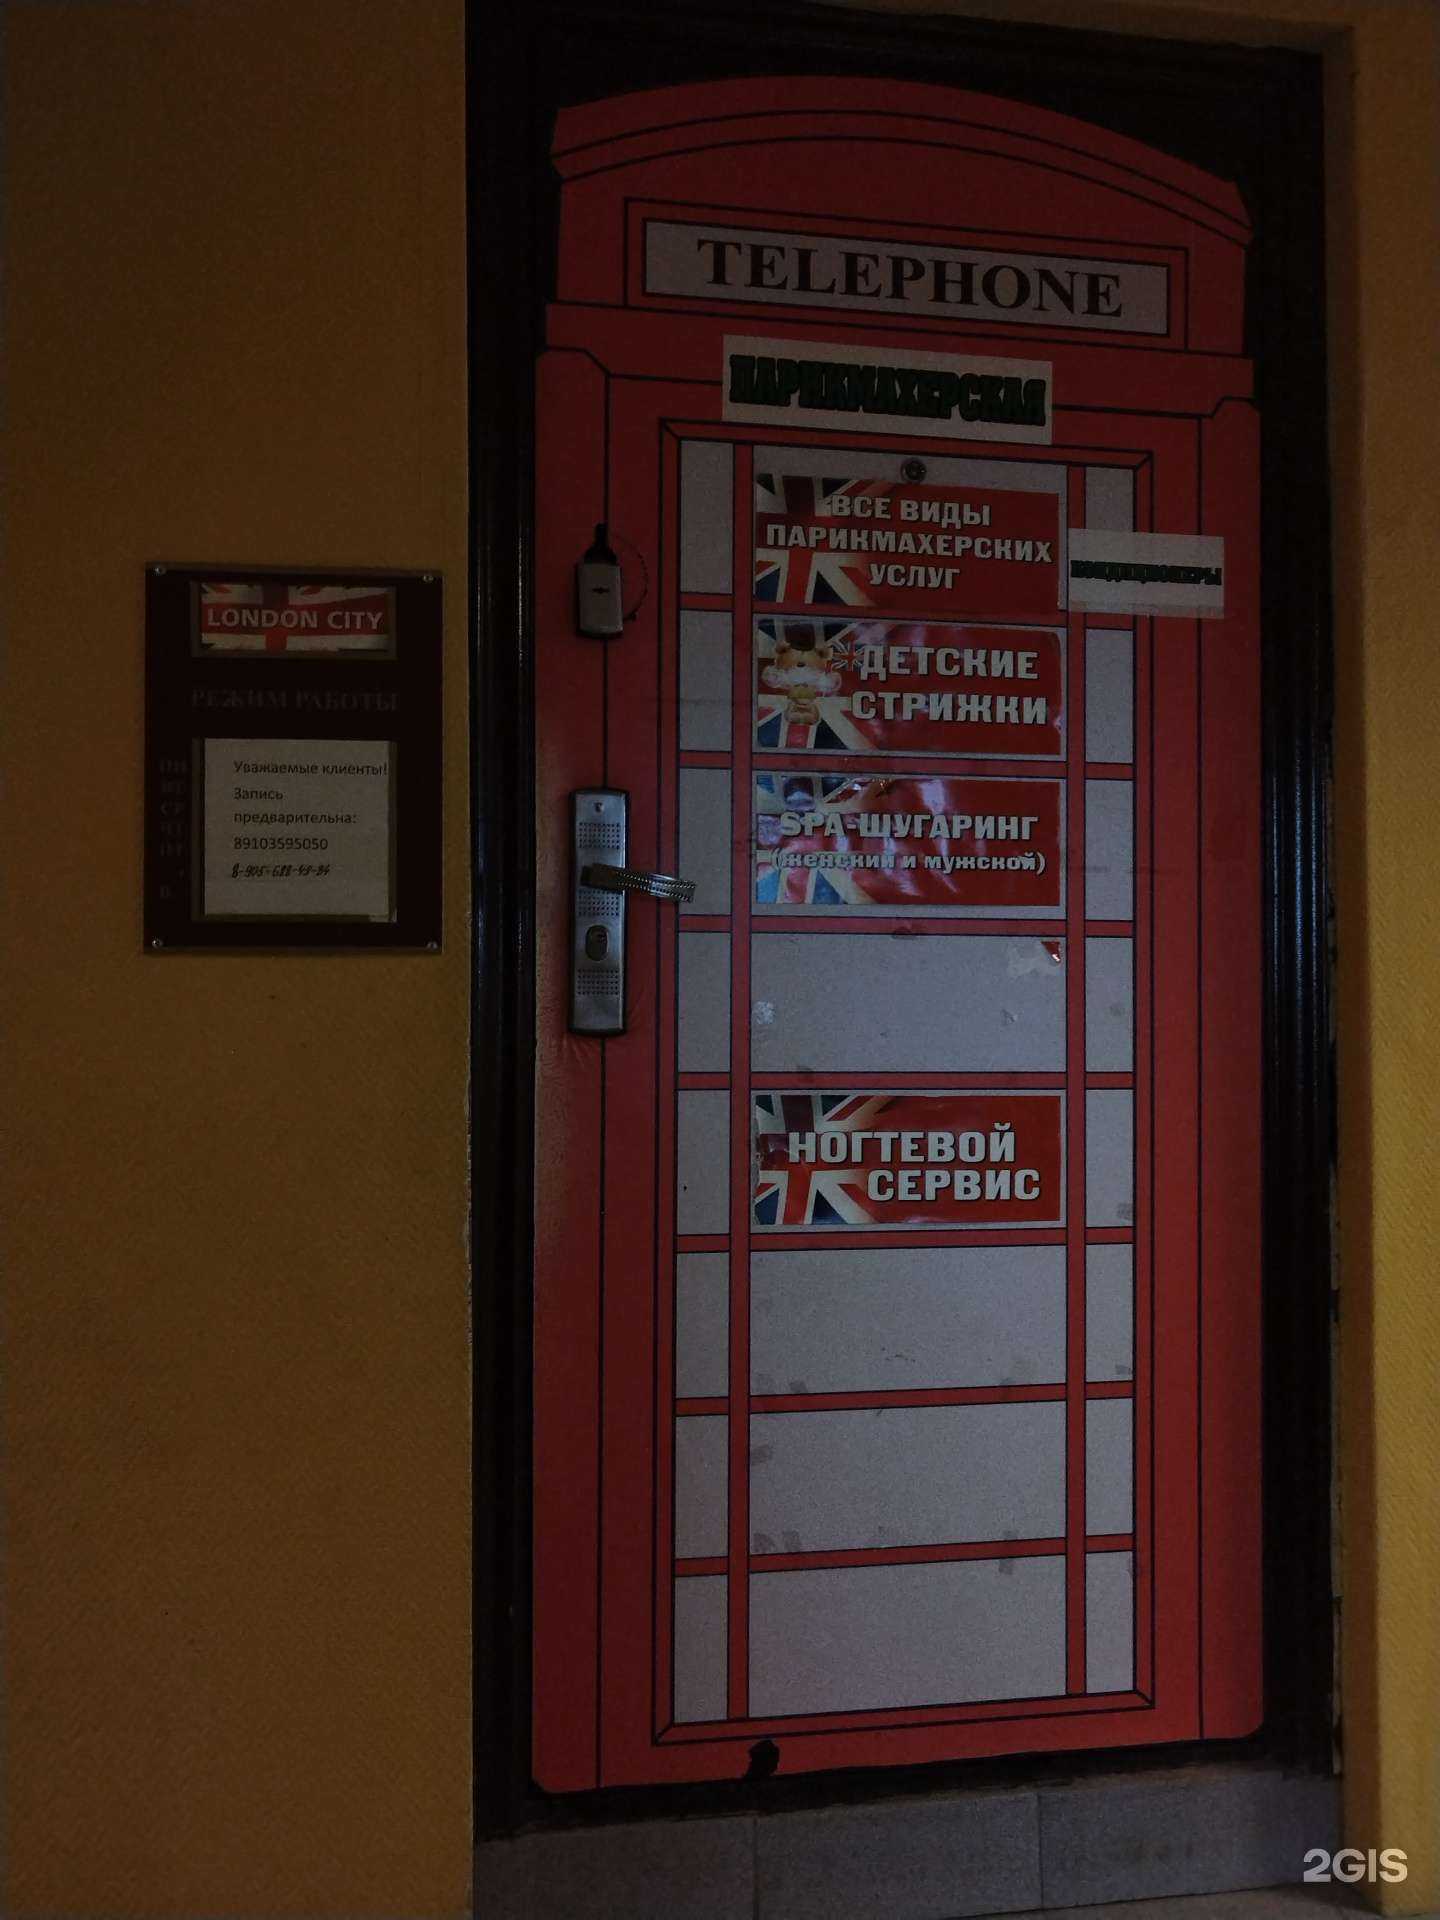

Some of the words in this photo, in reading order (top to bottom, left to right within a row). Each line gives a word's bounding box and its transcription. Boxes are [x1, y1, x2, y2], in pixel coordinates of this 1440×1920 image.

[697, 239, 1122, 318] TELEPHONE
[729, 355, 1046, 427] ПАРИКМАХЕРСКАЯ
[831, 495, 891, 520] ВСЕ
[900, 499, 991, 529] ВИДЫ
[766, 523, 1054, 564] ПАРИКМАХЕРСКИХ
[868, 564, 960, 590] УСЛУГ
[207, 608, 318, 629] LONDON
[327, 609, 384, 630] CITY
[859, 645, 1040, 681] ДЕТСКИЕ
[191, 688, 287, 710] РЕЖИМ
[296, 689, 398, 712] РАБОТЫ
[851, 691, 1048, 725] СТРИЖКИ
[233, 760, 318, 775] Уважаемые
[322, 762, 388, 776] клиенты!
[233, 787, 284, 801] Запись
[233, 811, 357, 826] предварительна:
[780, 812, 1040, 841] SPA-ШУГАРИНГ
[233, 837, 328, 850] 89103595050
[771, 848, 896, 871] (женский
[903, 854, 917, 869] и
[924, 850, 1046, 875] мужской)
[787, 1121, 1017, 1164] НОГТЕВОЙ
[867, 1169, 1041, 1202] СЕРВИС
